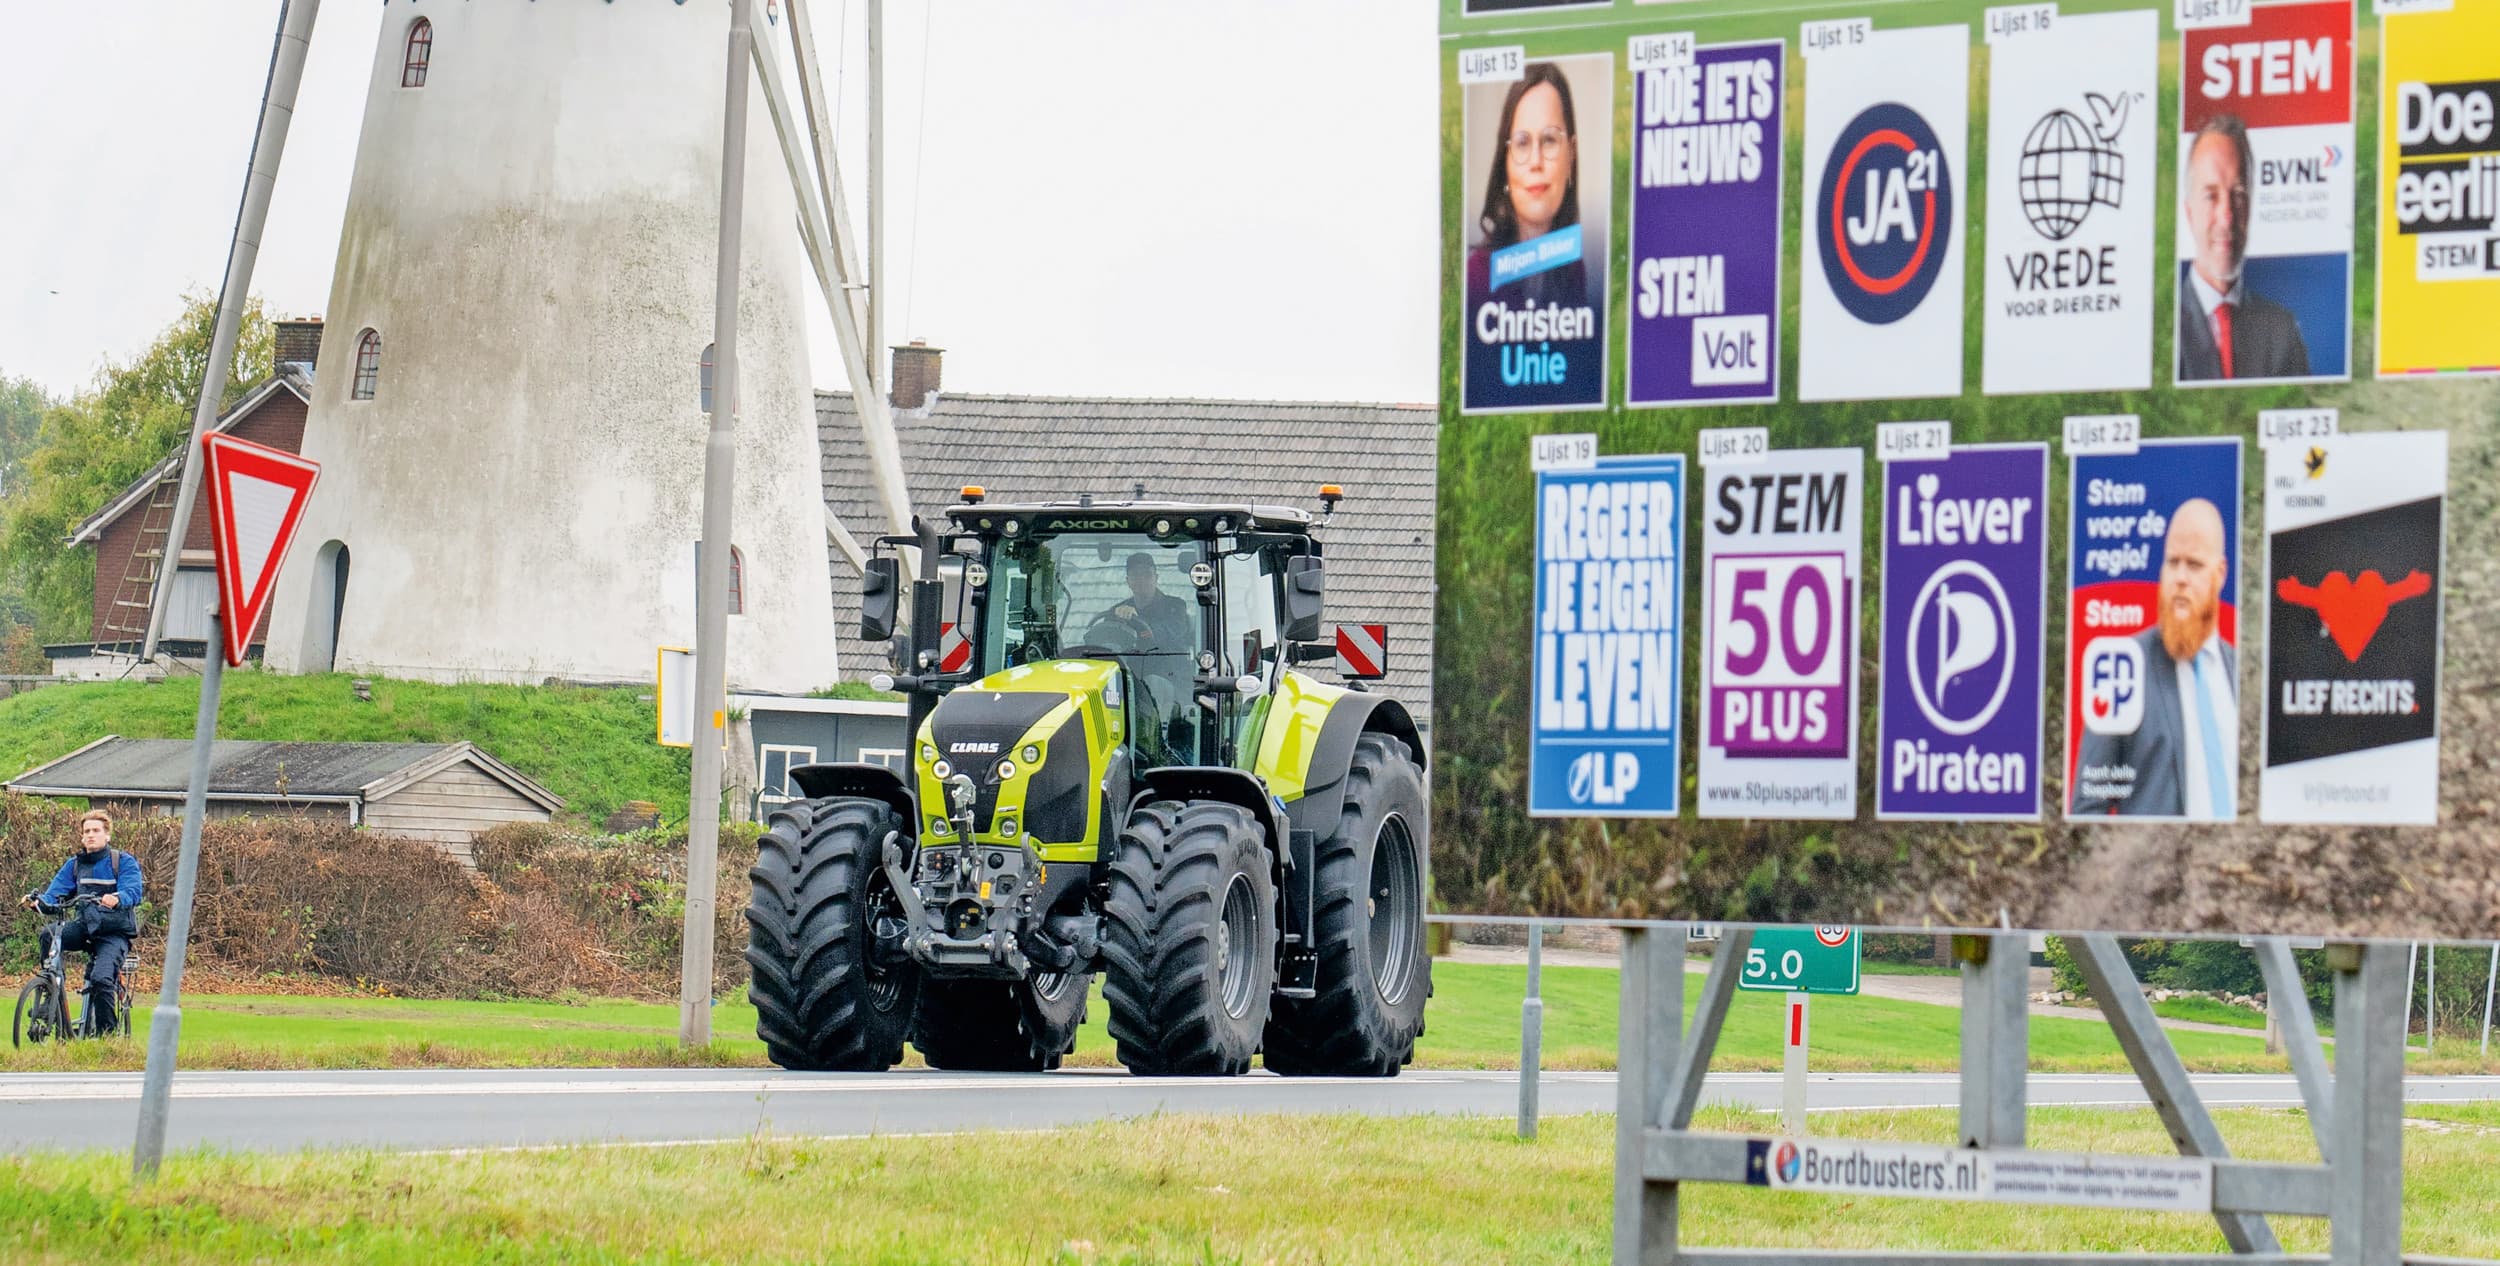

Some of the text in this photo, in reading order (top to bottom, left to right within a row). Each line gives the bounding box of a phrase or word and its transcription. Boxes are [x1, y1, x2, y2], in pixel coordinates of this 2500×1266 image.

[1808, 24, 1865, 50] Lijst 15
[1992, 9, 2050, 36] Lijst 16
[1465, 51, 1518, 76] Lijst 13
[1634, 38, 1688, 63] Lijst 14
[2201, 36, 2332, 99] STEM
[1643, 58, 1775, 126] DOE IETS
[2397, 81, 2494, 144] Doe
[1641, 120, 1763, 188] NIEUWS
[2261, 157, 2327, 186] BVNL
[2005, 245, 2116, 291] VREDE
[2424, 245, 2478, 268] STEM
[1638, 255, 1725, 318] STEM
[1476, 299, 1594, 344] Christen
[2005, 294, 2121, 317] VOOR DIEREN
[1501, 343, 1566, 384] Unie
[1703, 330, 1757, 369] Volt
[1704, 434, 1763, 458] Lijst 20
[1885, 428, 1942, 452] Lijst 21
[2070, 421, 2132, 446] Lijst 22
[2266, 416, 2331, 441] Lijst 23
[1538, 441, 1590, 464] Lijst 19
[1714, 473, 1848, 535] STEM
[1898, 474, 2032, 545] Liever
[2087, 478, 2146, 506] Stem
[1048, 519, 1129, 529] AXION
[1543, 481, 1674, 561] REGEER
[2086, 509, 2166, 539] voor de
[2085, 541, 2150, 577] regio!
[1542, 559, 1673, 633] JE EIGEN
[2085, 598, 2144, 628] Stem
[1725, 564, 1832, 677] 50
[1539, 631, 1672, 731] LEVEN
[2282, 680, 2420, 715] LIEF RECHTS.
[1724, 689, 1828, 742] PLUS
[950, 742, 999, 753] CLAAS
[1592, 752, 1639, 804] LP
[1893, 738, 2026, 793] Piraten
[1708, 781, 1847, 806] www.50pluspartij.nl
[1746, 948, 1804, 981] 5,0
